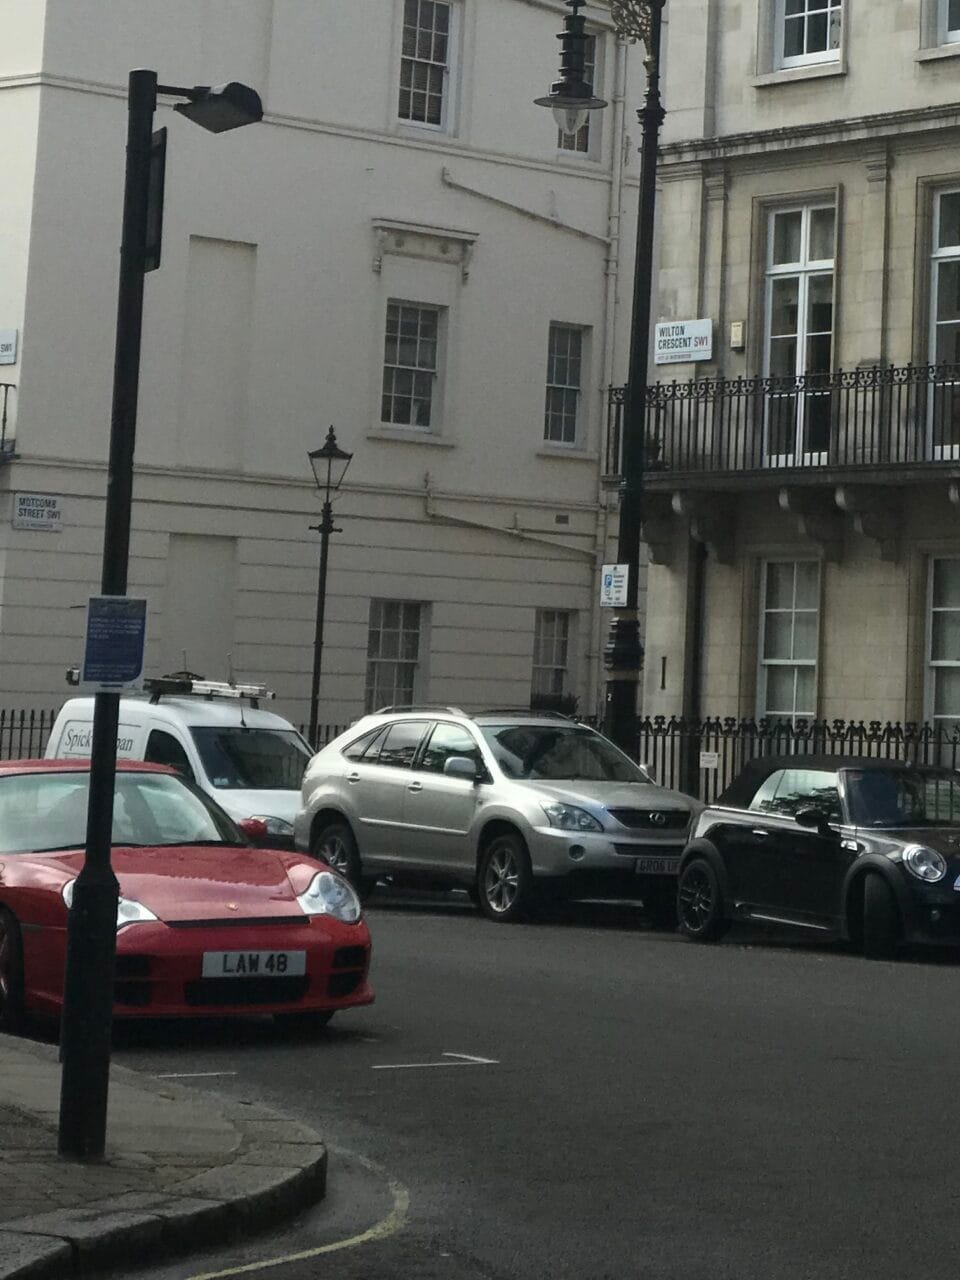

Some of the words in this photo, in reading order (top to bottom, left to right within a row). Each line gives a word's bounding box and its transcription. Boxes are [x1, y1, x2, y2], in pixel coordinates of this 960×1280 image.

[659, 325, 685, 337] WILTON
[658, 336, 692, 350] CRESCENT
[693, 335, 708, 348] SW1
[19, 497, 57, 509] MOTCOMB
[18, 507, 45, 519] STREET
[46, 510, 61, 520] SW1
[222, 953, 260, 974] LAW
